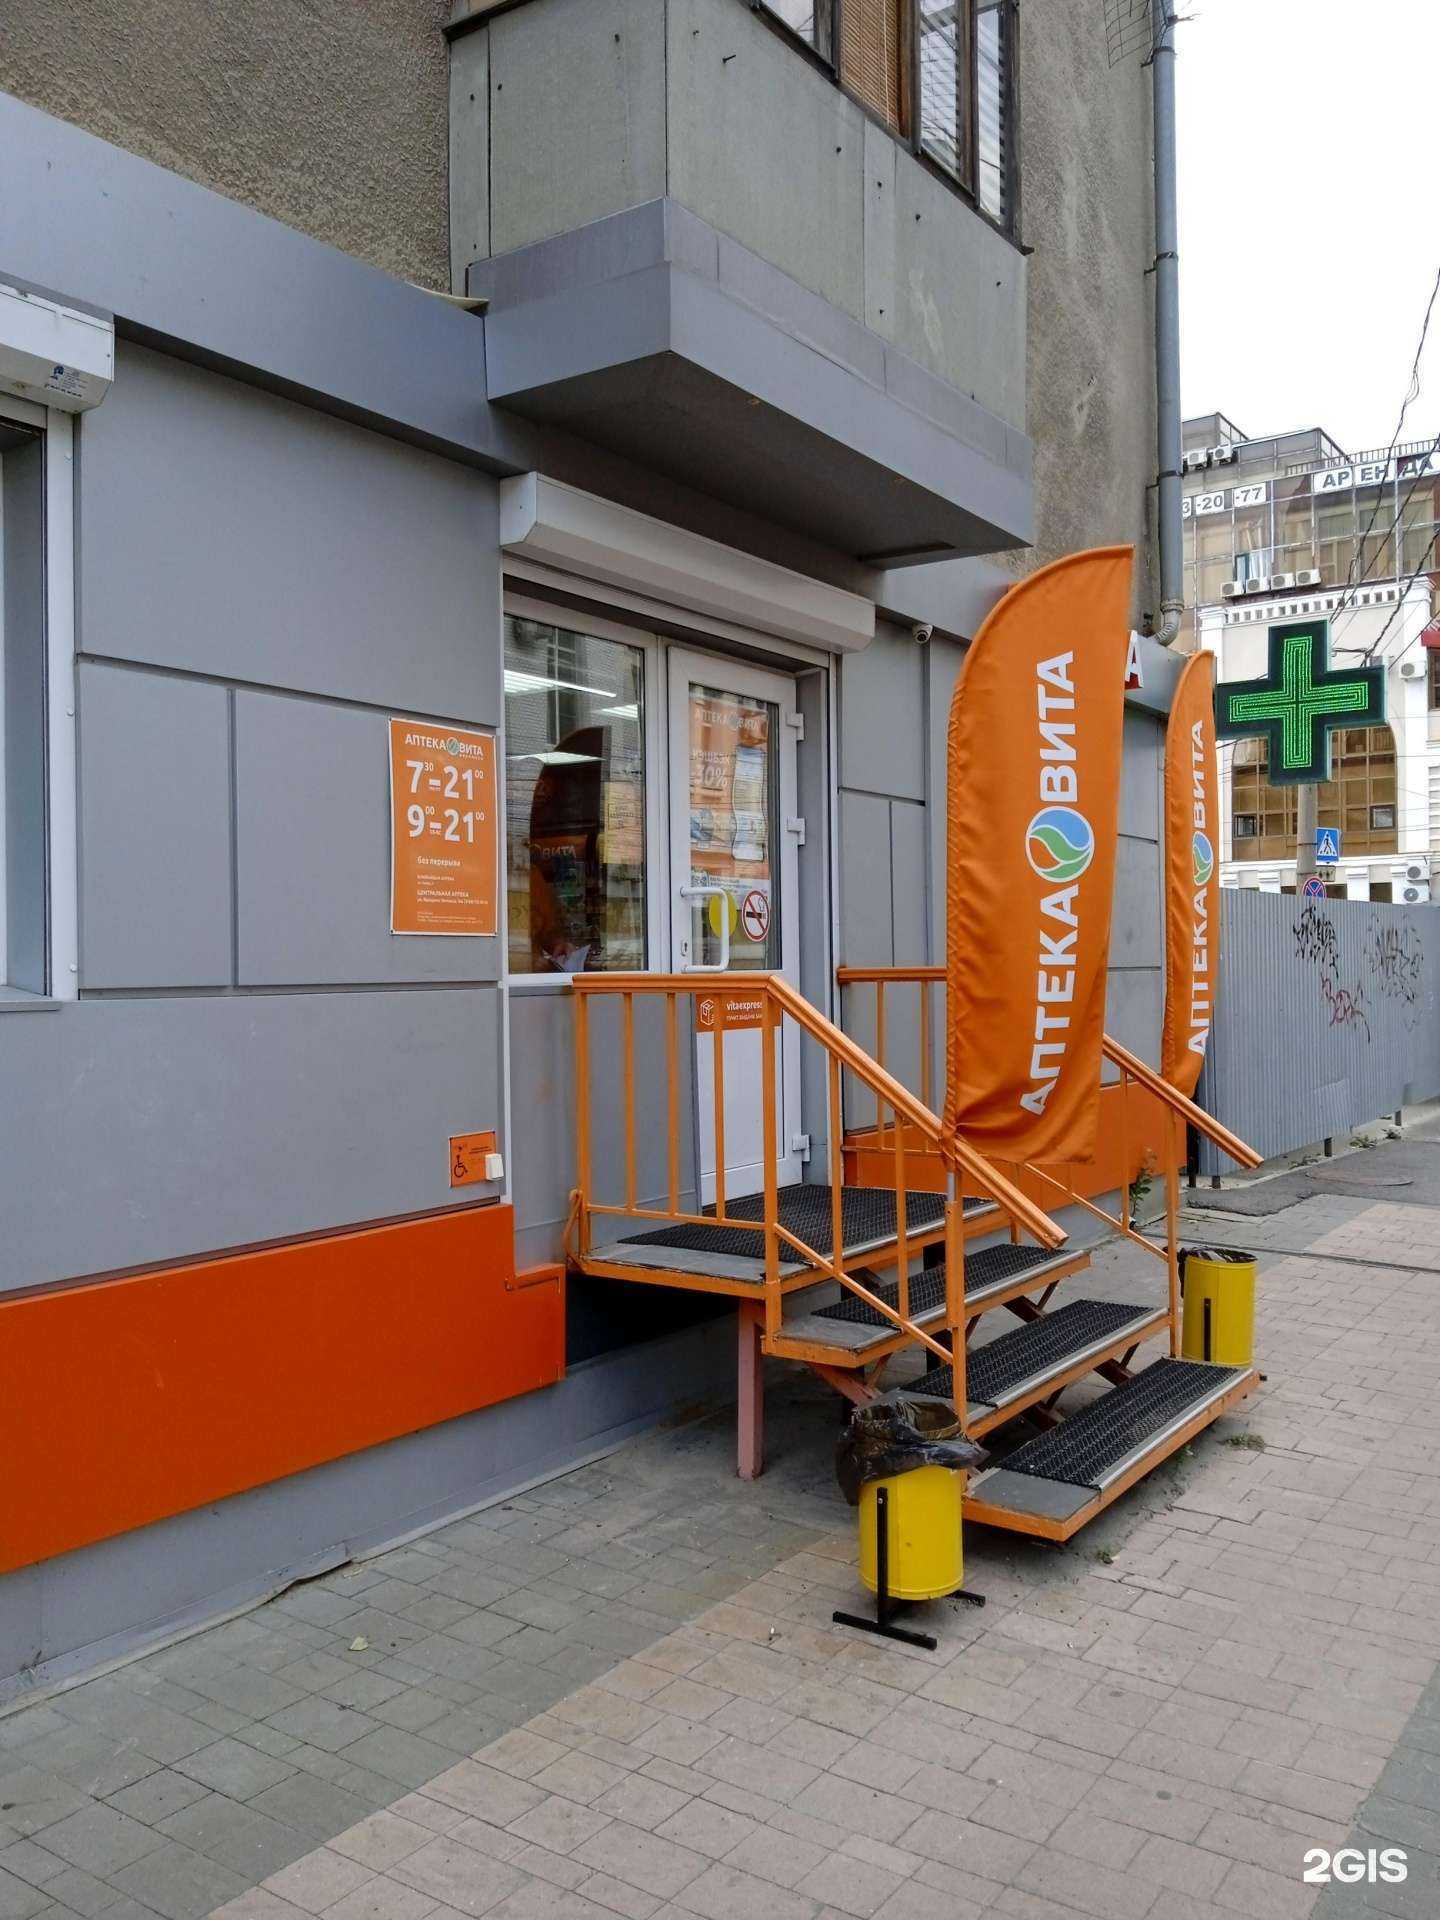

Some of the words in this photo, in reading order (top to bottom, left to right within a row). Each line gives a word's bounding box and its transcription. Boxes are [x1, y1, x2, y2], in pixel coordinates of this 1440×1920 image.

[405, 733, 447, 751] АПТЕКА
[460, 742, 483, 757] ВИТА
[1036, 650, 1078, 802] ВИТА
[1190, 719, 1206, 829] ВИТА
[1019, 885, 1079, 1116] АПТЕКА
[1187, 887, 1210, 1057] АПТЕКА
